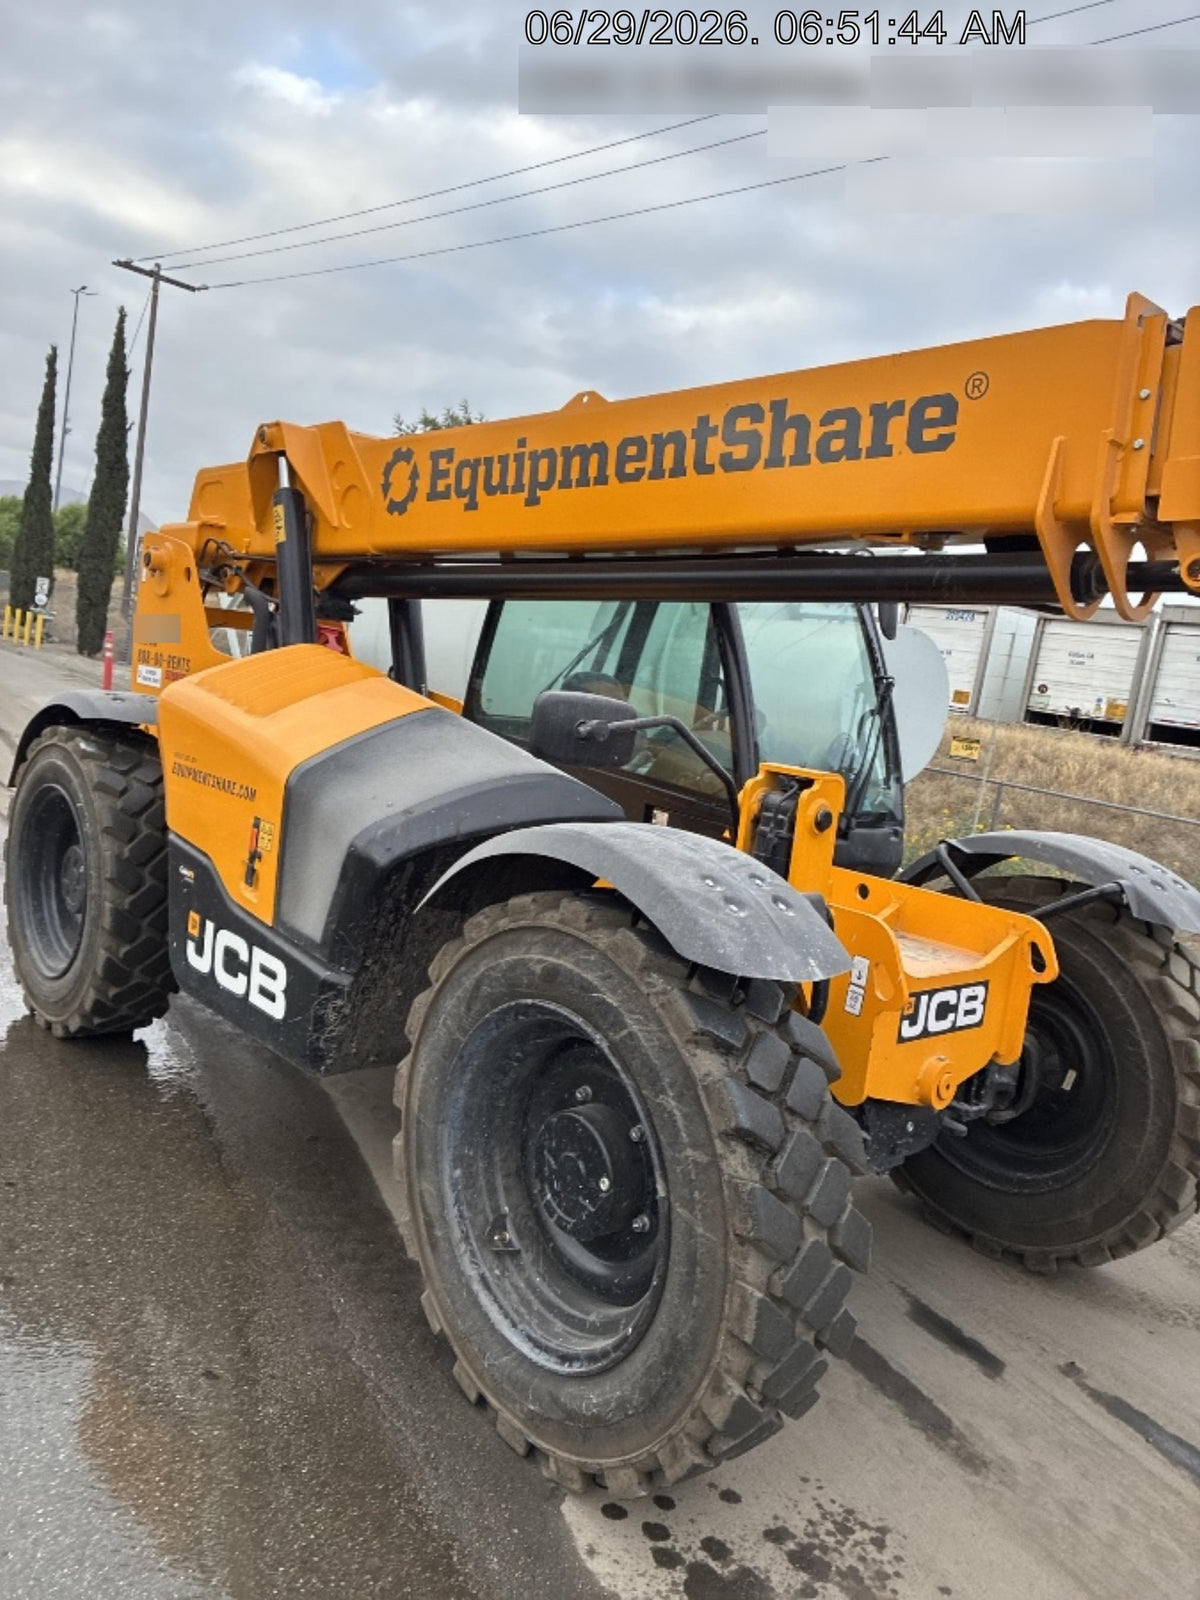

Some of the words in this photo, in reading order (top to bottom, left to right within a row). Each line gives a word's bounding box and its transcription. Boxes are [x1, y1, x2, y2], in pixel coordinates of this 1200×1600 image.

[426, 392, 959, 510] EquipmentShare
[186, 918, 287, 1020] JCB
[900, 985, 986, 1038] JCB
